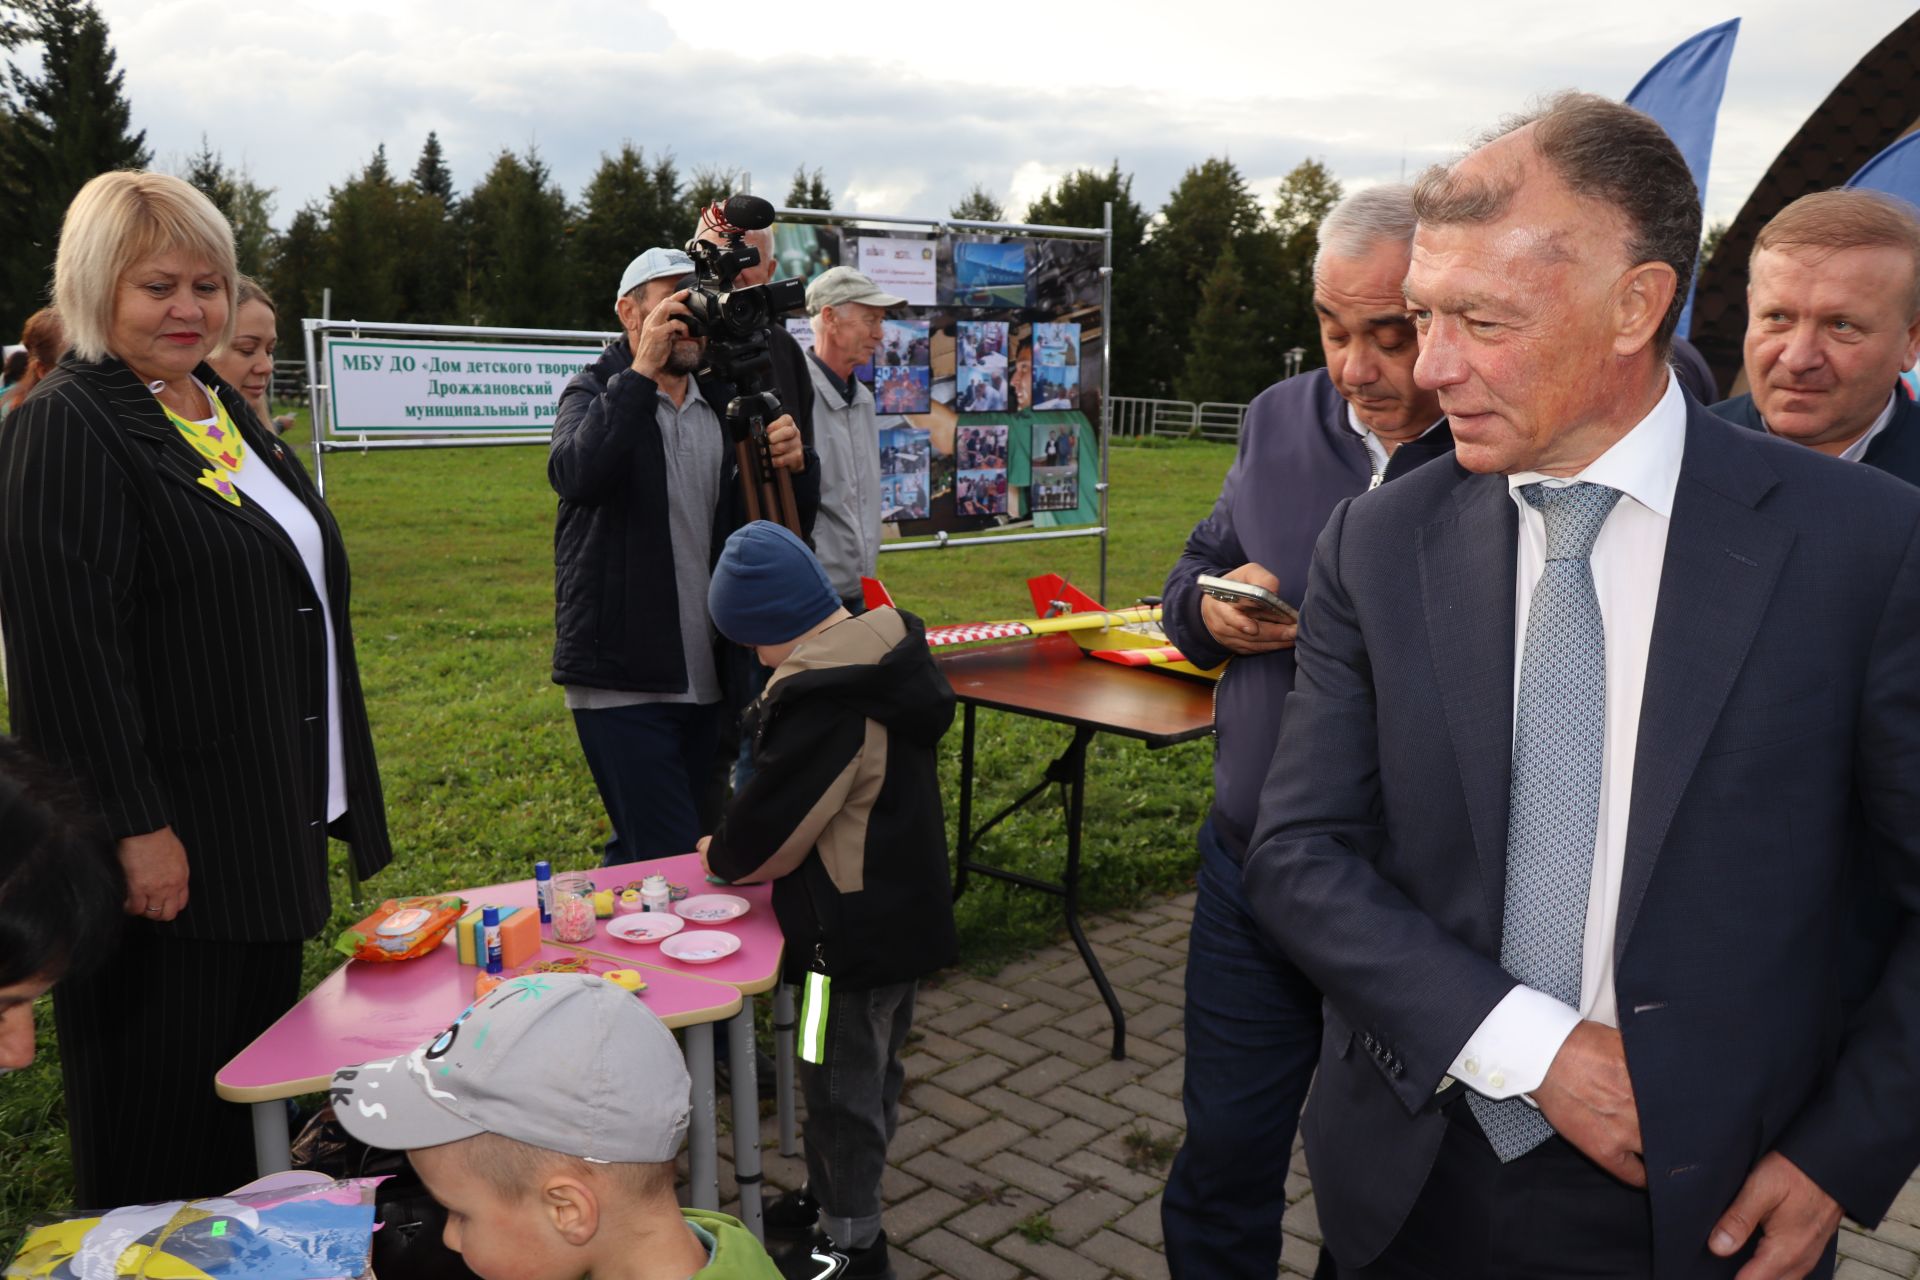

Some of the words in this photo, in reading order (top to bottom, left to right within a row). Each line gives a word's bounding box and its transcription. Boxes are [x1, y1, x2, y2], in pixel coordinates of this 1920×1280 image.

[342, 354, 384, 371] МБУ
[389, 355, 417, 374] ДО
[422, 356, 462, 374] «Дом
[467, 362, 532, 374] детского
[536, 363, 586, 377] творче
[428, 379, 553, 398] Дрожжановский
[405, 402, 529, 420] муниципальный
[535, 402, 560, 419] рай
